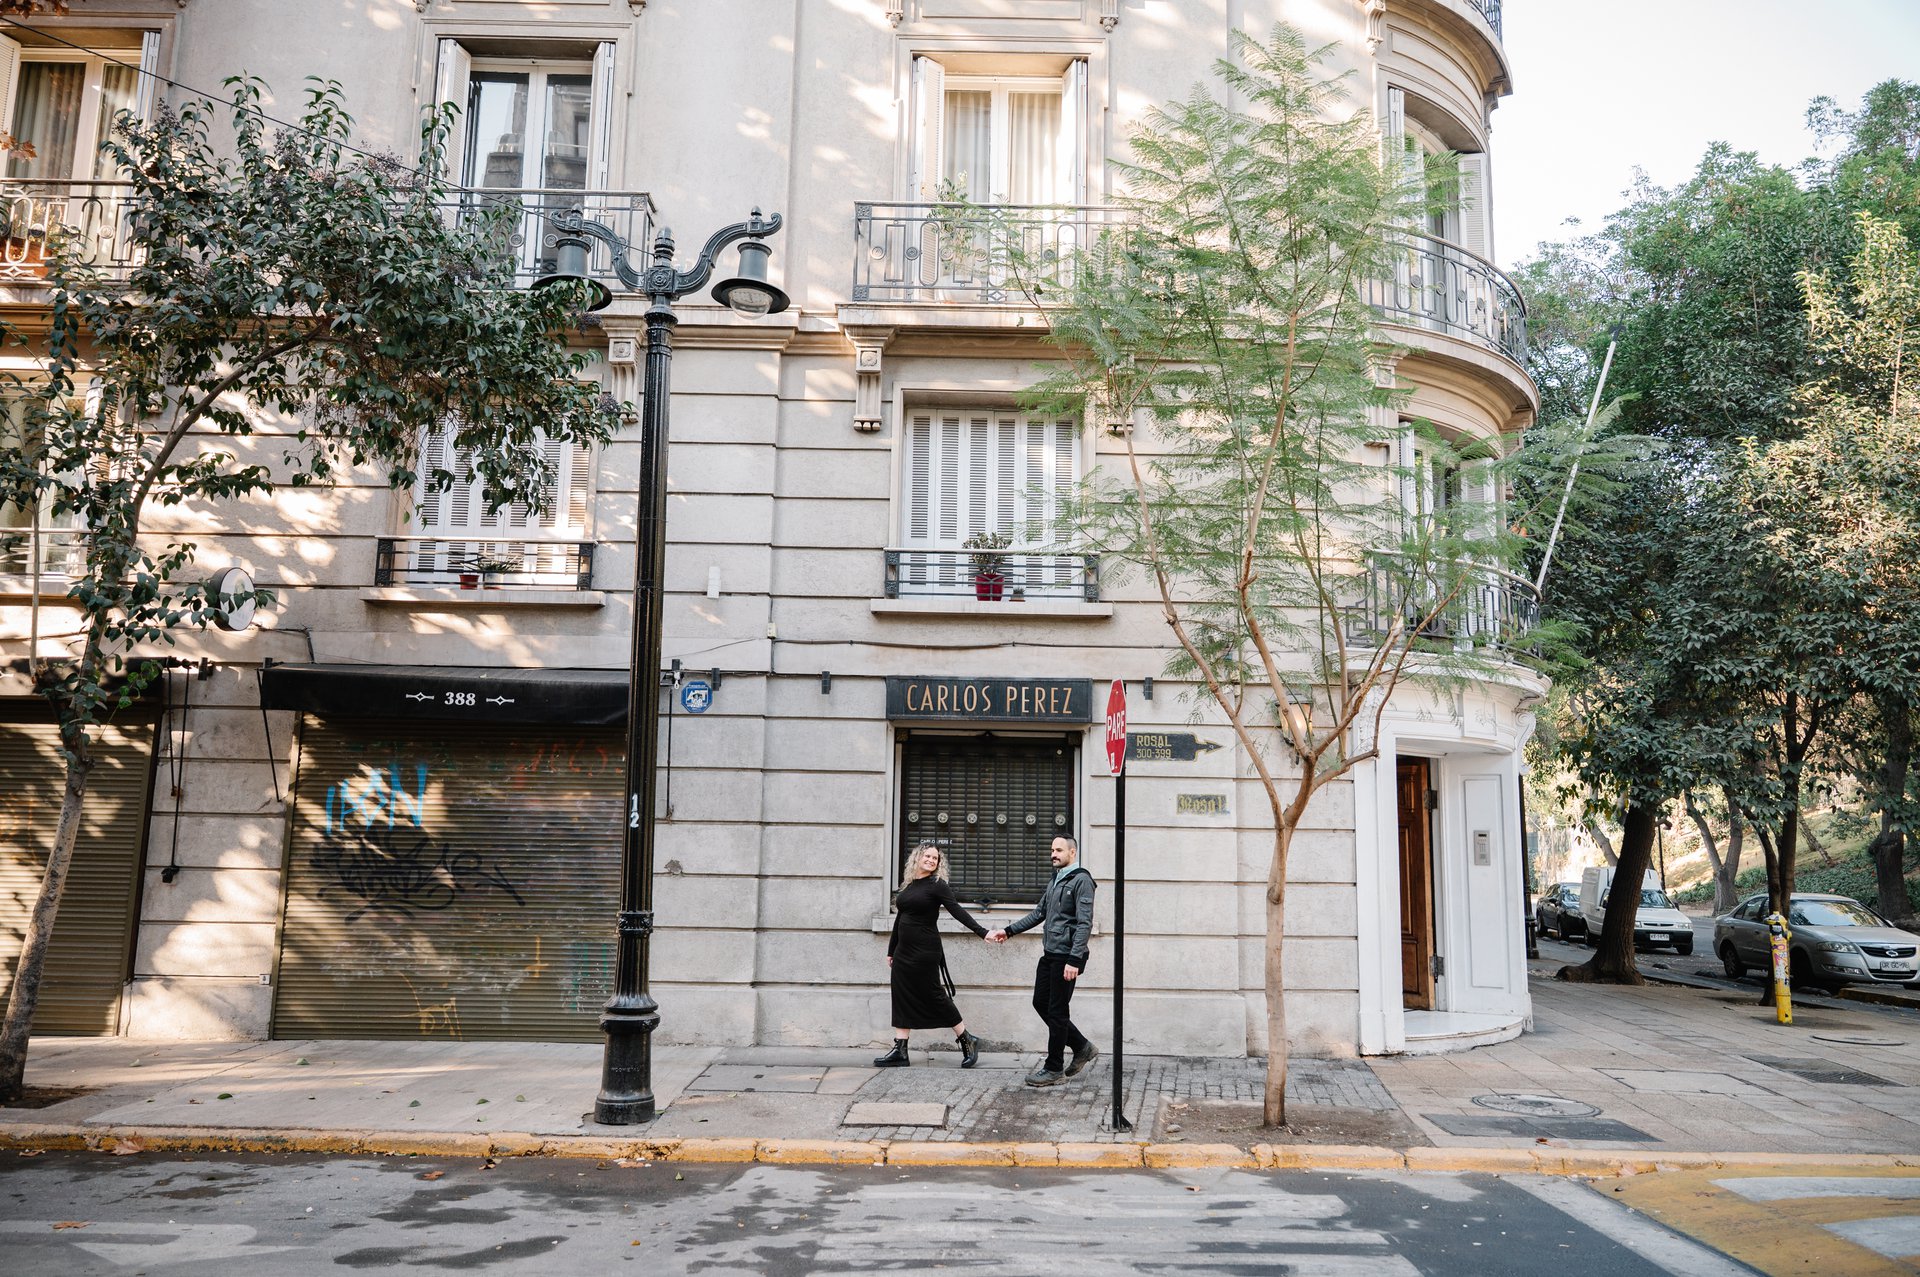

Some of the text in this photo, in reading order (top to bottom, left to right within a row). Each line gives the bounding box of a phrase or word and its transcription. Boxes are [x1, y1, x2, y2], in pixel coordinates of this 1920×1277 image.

[444, 692, 476, 706] 388
[906, 684, 1073, 714] CARLOS PEREZ
[1106, 710, 1125, 742] PARE
[1136, 735, 1172, 747] ROSAL
[1136, 748, 1172, 759] 300-399
